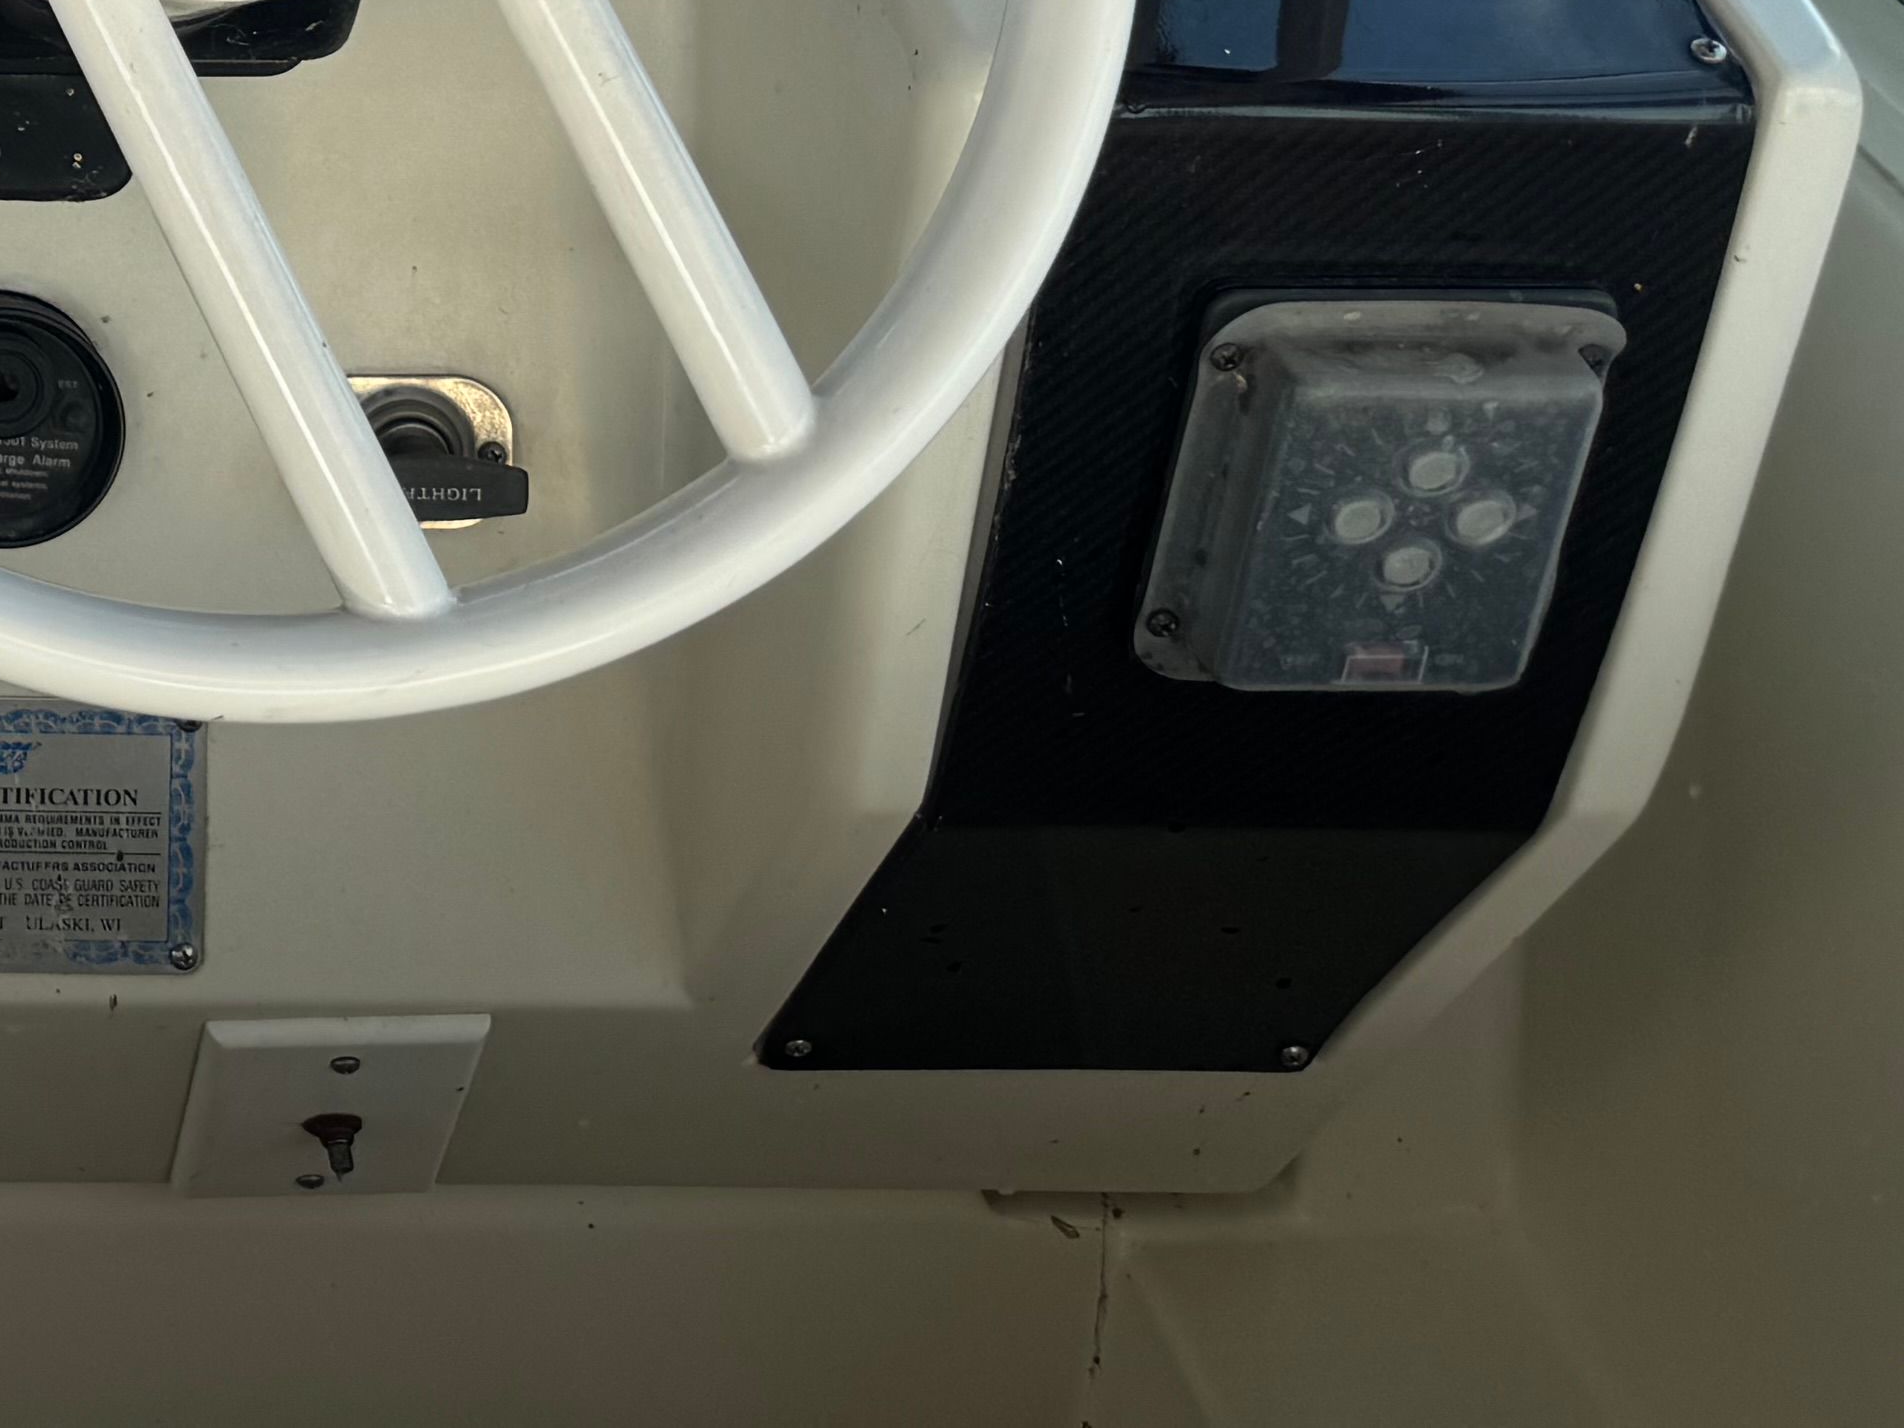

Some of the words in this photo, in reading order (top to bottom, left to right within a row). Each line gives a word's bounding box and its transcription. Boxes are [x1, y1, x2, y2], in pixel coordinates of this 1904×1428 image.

[31, 437, 79, 452] System
[32, 454, 71, 468] Alarm
[25, 814, 105, 826] REQUIREMENTS
[110, 815, 121, 826] IN
[125, 816, 161, 827] EFFECT
[75, 827, 159, 839] MANUFACTURER
[61, 839, 108, 851] CONTROL
[72, 862, 156, 873] ASSOCIATION
[31, 877, 70, 892] COAST
[73, 879, 114, 893] GUARD
[119, 879, 161, 893] SAFETY
[24, 893, 52, 906] DATE
[77, 894, 161, 908] CERTIFICATION
[100, 917, 122, 932] WI
